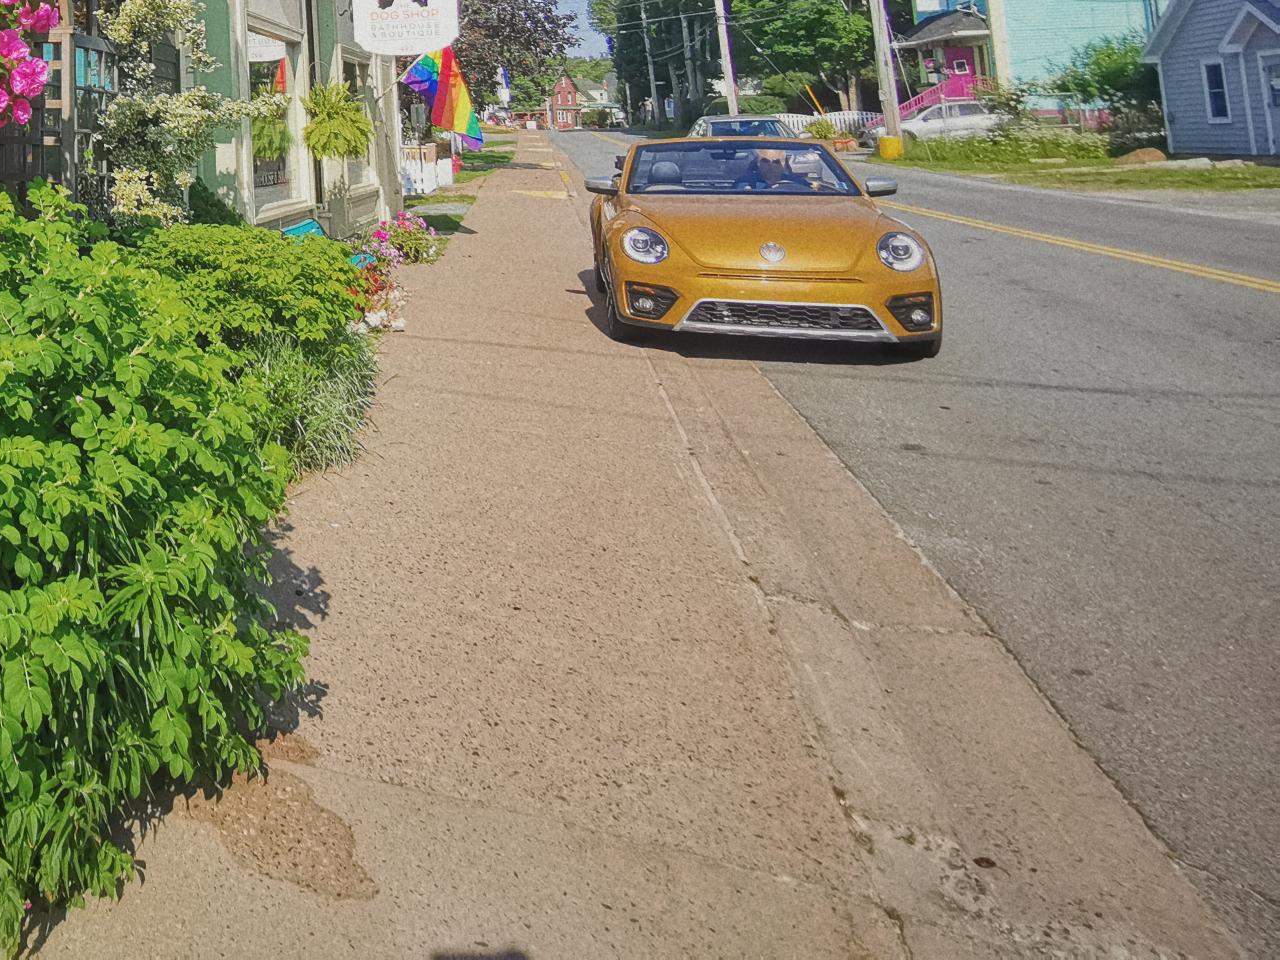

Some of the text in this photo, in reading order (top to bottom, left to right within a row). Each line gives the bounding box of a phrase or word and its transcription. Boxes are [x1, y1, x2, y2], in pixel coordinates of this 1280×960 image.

[370, 9, 440, 20] DOG SHOP
[370, 22, 440, 31] BATHHOUSE
[381, 30, 440, 38] BOUTIQUE
